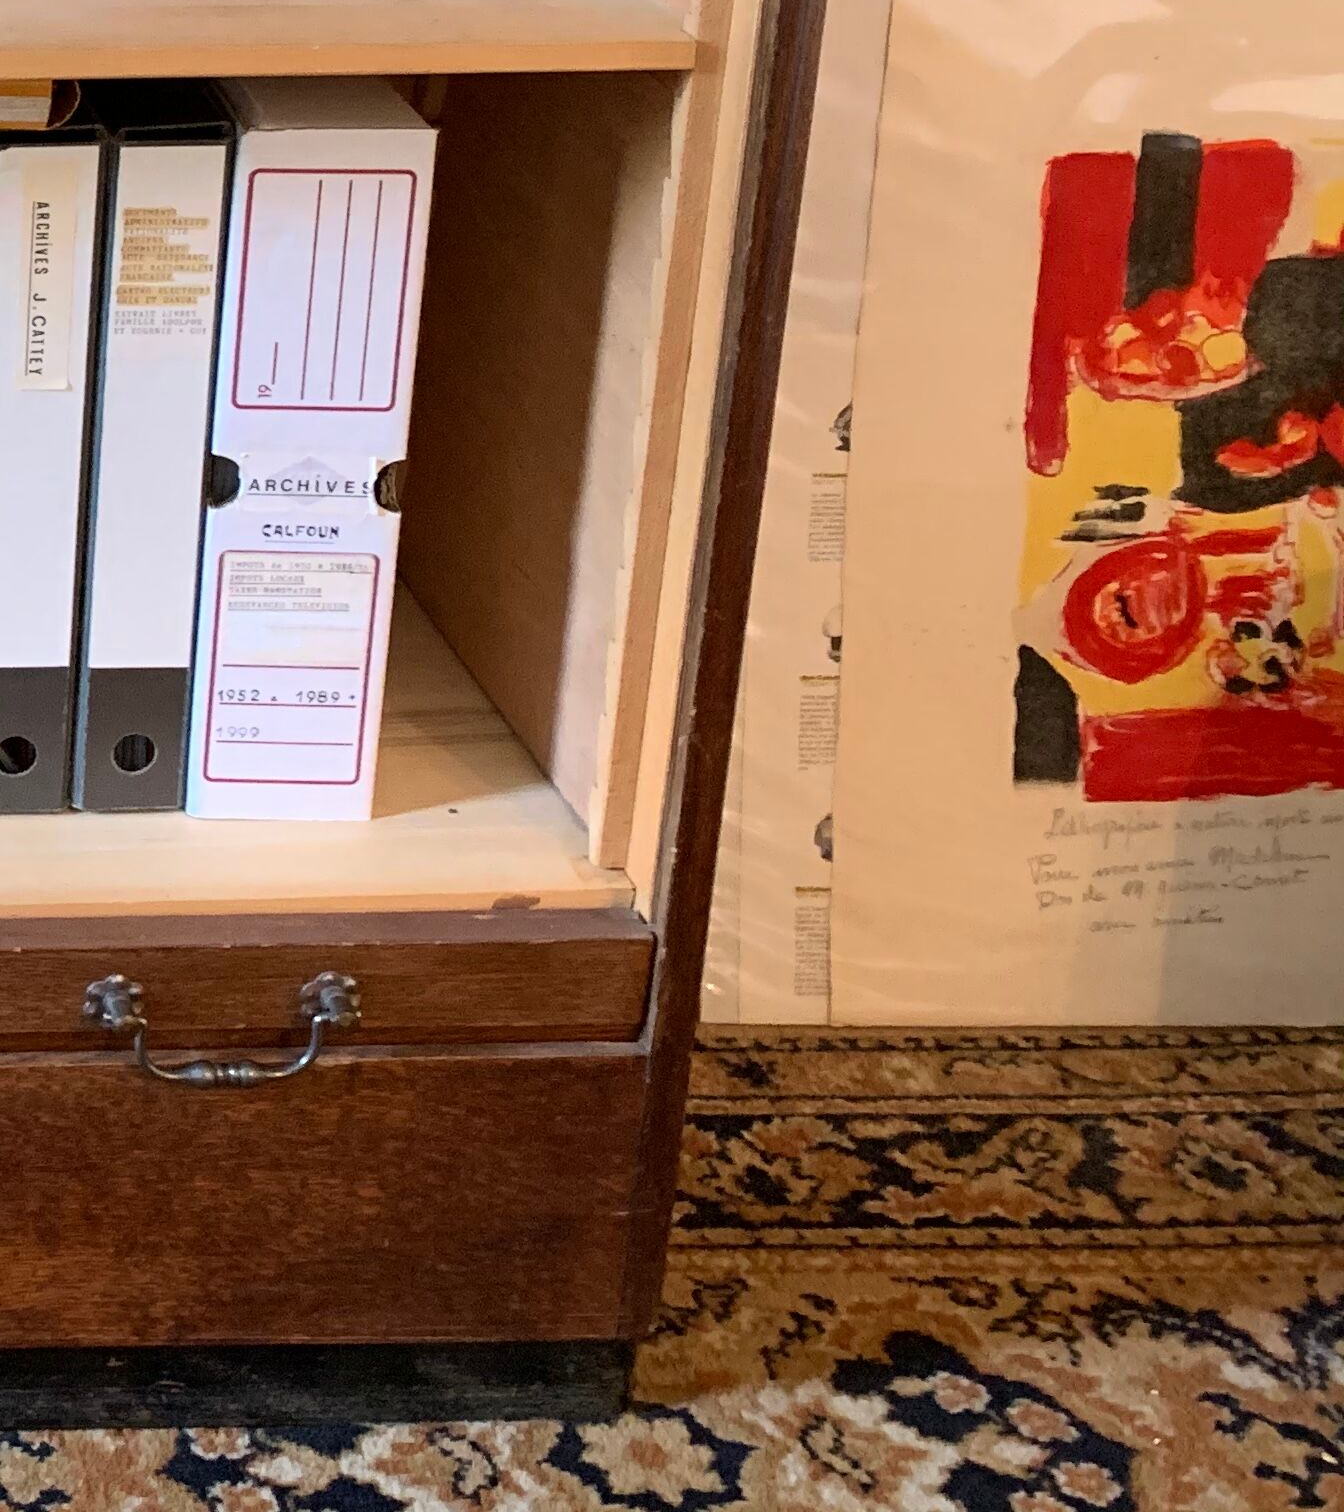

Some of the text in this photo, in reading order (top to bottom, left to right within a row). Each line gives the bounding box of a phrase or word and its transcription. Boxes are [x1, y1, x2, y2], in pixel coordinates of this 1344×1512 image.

[33, 201, 53, 275] ARCHIVES
[249, 474, 369, 494] ARCHIVES
[217, 689, 260, 701] 1952
[296, 690, 341, 703] 1989
[216, 726, 261, 738] 1999
